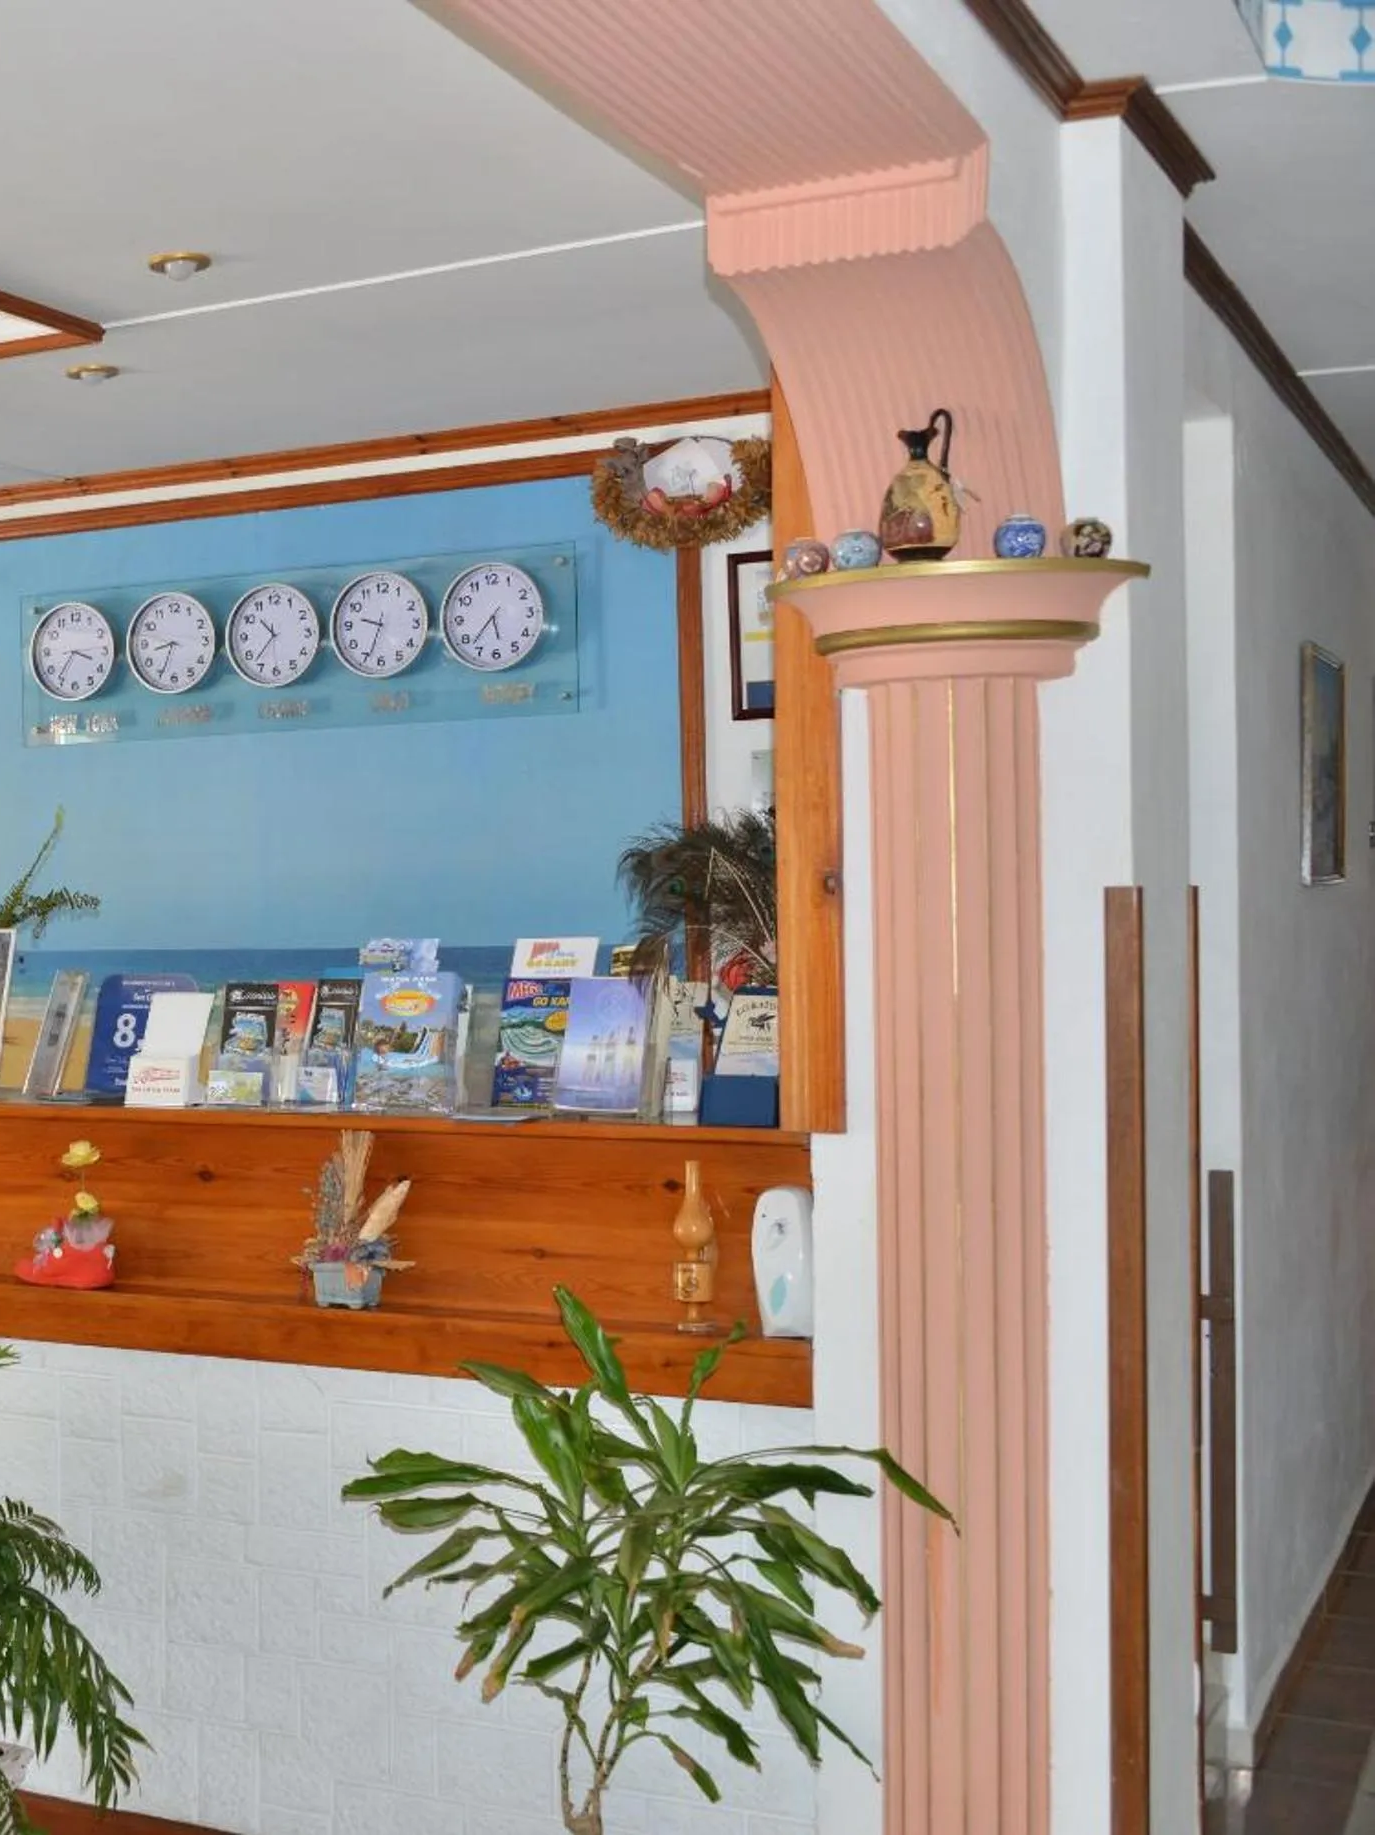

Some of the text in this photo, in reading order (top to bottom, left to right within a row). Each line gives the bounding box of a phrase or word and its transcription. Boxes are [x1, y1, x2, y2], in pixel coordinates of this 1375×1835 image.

[485, 573, 499, 585] 12
[506, 576, 511, 587] 1
[376, 582, 389, 593] 12
[395, 586, 400, 596] 1
[469, 581, 479, 592] 11
[361, 589, 370, 600] 11
[518, 588, 528, 600] 2
[268, 594, 281, 605] 12
[458, 595, 472, 607] 10
[169, 603, 180, 613] 12
[254, 601, 263, 611] 11
[350, 602, 362, 612] 10
[407, 600, 415, 611] 2
[155, 609, 163, 619] 11
[298, 610, 306, 620] 2
[526, 606, 534, 618] 3
[197, 619, 204, 629] 2
[244, 614, 255, 624] 10
[412, 618, 420, 629] 3
[454, 615, 464, 625] 9
[145, 621, 156, 631] 10
[344, 621, 353, 631] 9
[240, 632, 248, 642] 9
[304, 628, 312, 638] 3
[521, 627, 530, 638] 4
[202, 635, 209, 646] 3
[406, 638, 414, 648] 4
[461, 634, 470, 644] 8
[349, 640, 358, 649] 8
[511, 641, 519, 653] 5
[245, 650, 253, 660] 8
[300, 647, 308, 656] 4
[395, 650, 403, 661] 5
[475, 646, 483, 657] 7
[492, 648, 501, 660] 6
[197, 656, 204, 664] 4
[361, 652, 369, 663] 7
[377, 656, 385, 666] 6
[257, 663, 265, 672] 7
[289, 660, 297, 670] 5
[187, 667, 194, 677] 5
[272, 666, 281, 676] 6
[170, 673, 178, 683] 6
[113, 1013, 136, 1048] 8
